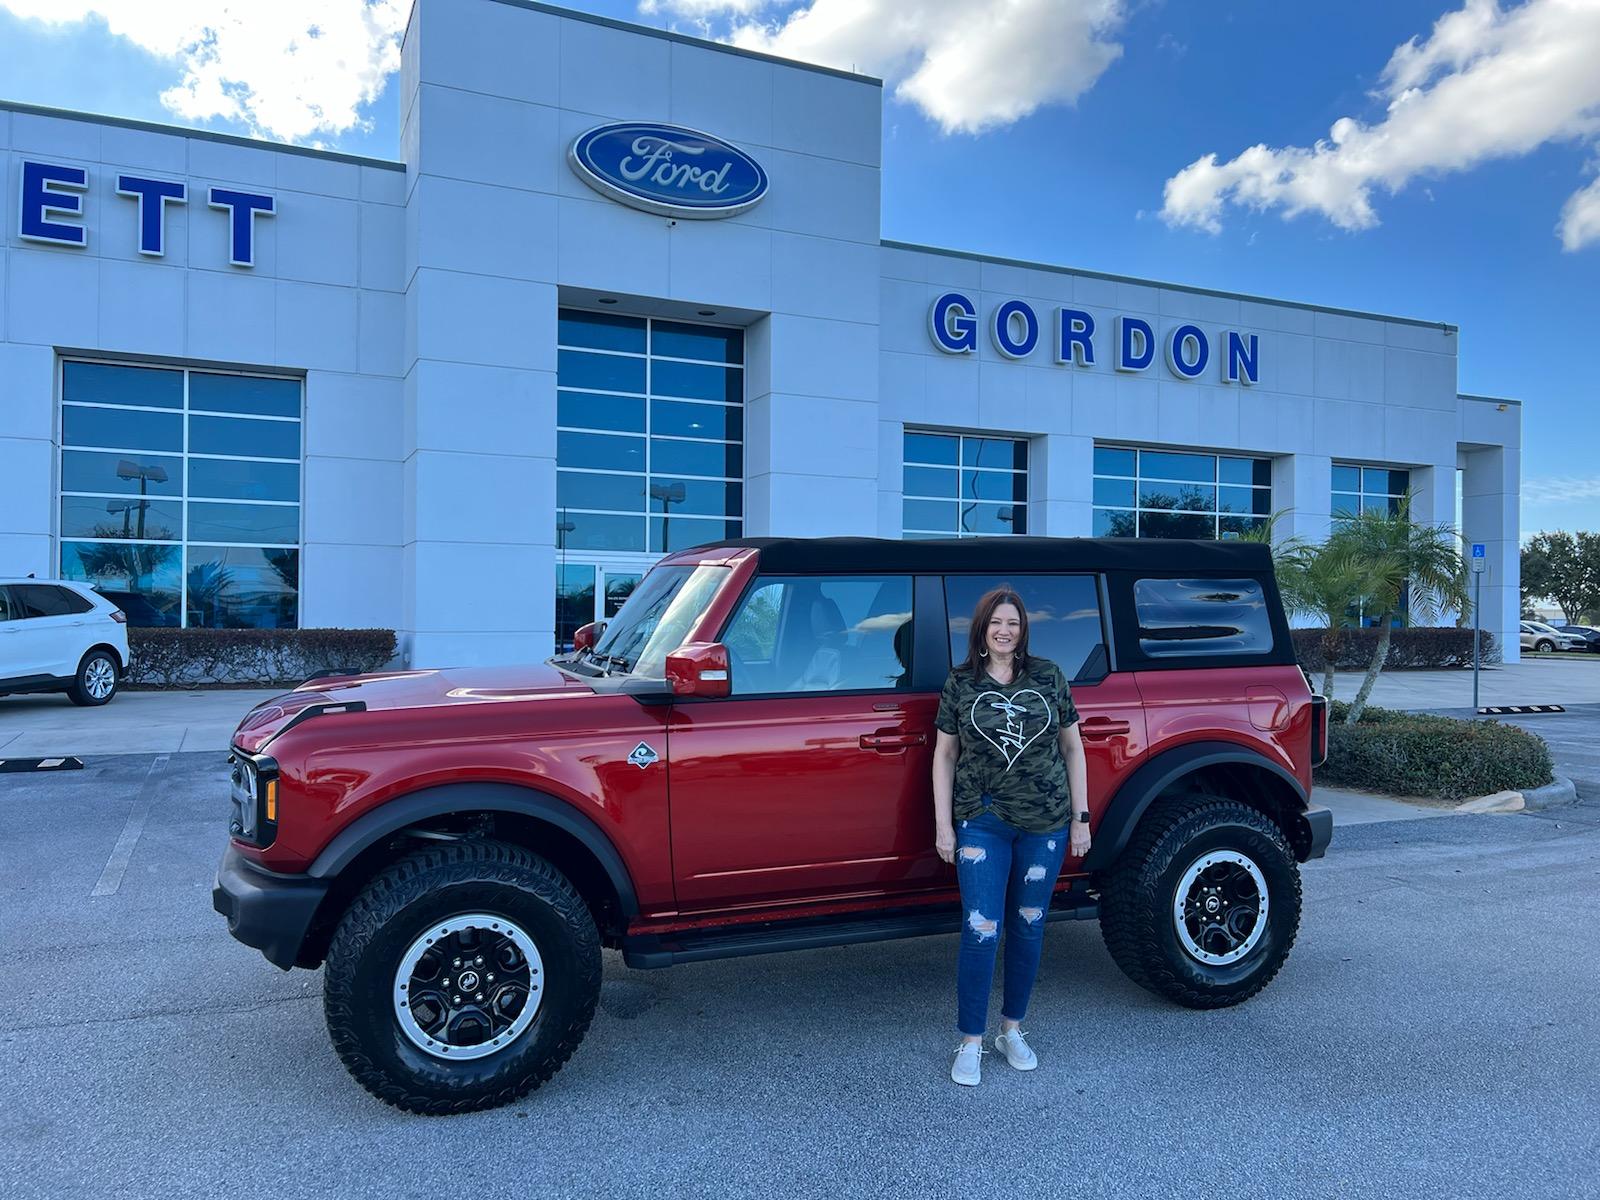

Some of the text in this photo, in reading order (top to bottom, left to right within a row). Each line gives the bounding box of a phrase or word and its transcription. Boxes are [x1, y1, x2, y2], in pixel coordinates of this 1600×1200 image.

[619, 135, 733, 194] Ford
[18, 158, 277, 268] ETT
[929, 291, 1260, 386] GORDON
